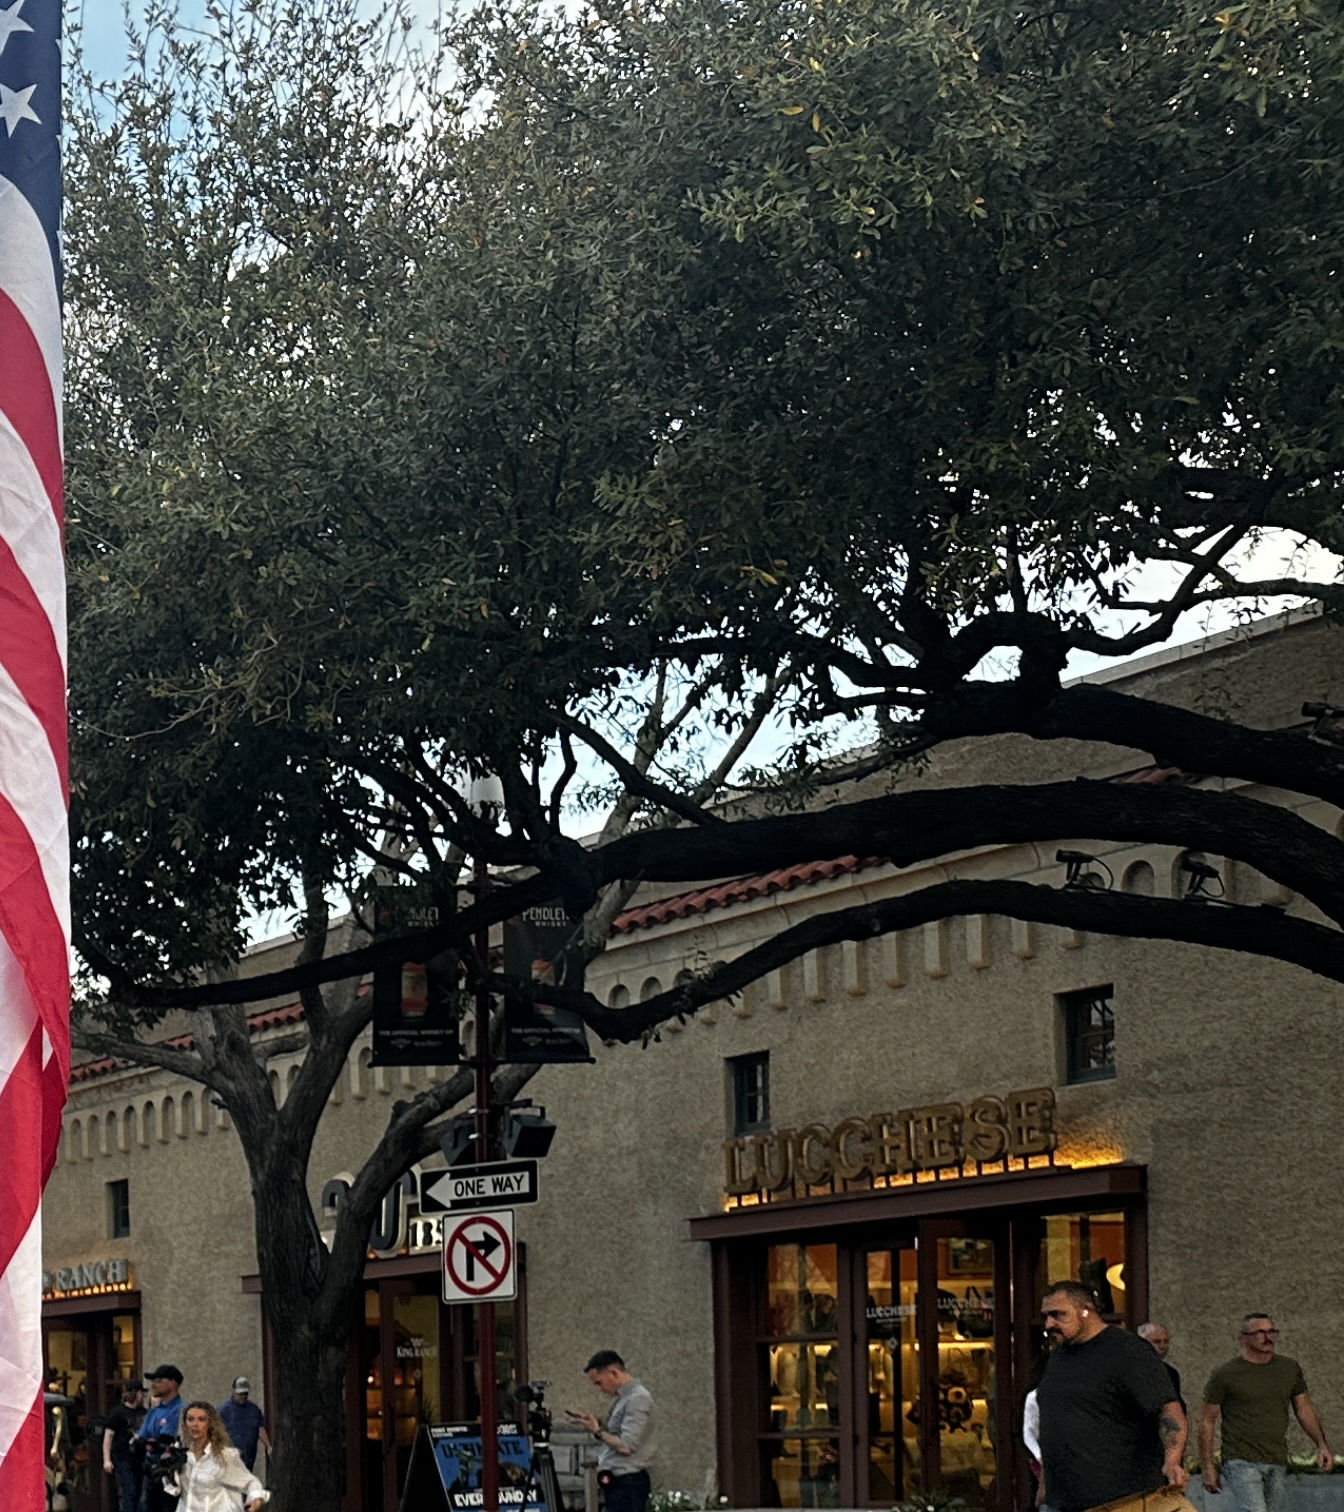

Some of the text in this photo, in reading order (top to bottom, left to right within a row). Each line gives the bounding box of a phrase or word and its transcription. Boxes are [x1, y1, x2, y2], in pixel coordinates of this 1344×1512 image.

[723, 1087, 1057, 1193] LUCCHESE
[454, 1174, 525, 1198] ONE WAY
[56, 1259, 130, 1292] RANCH
